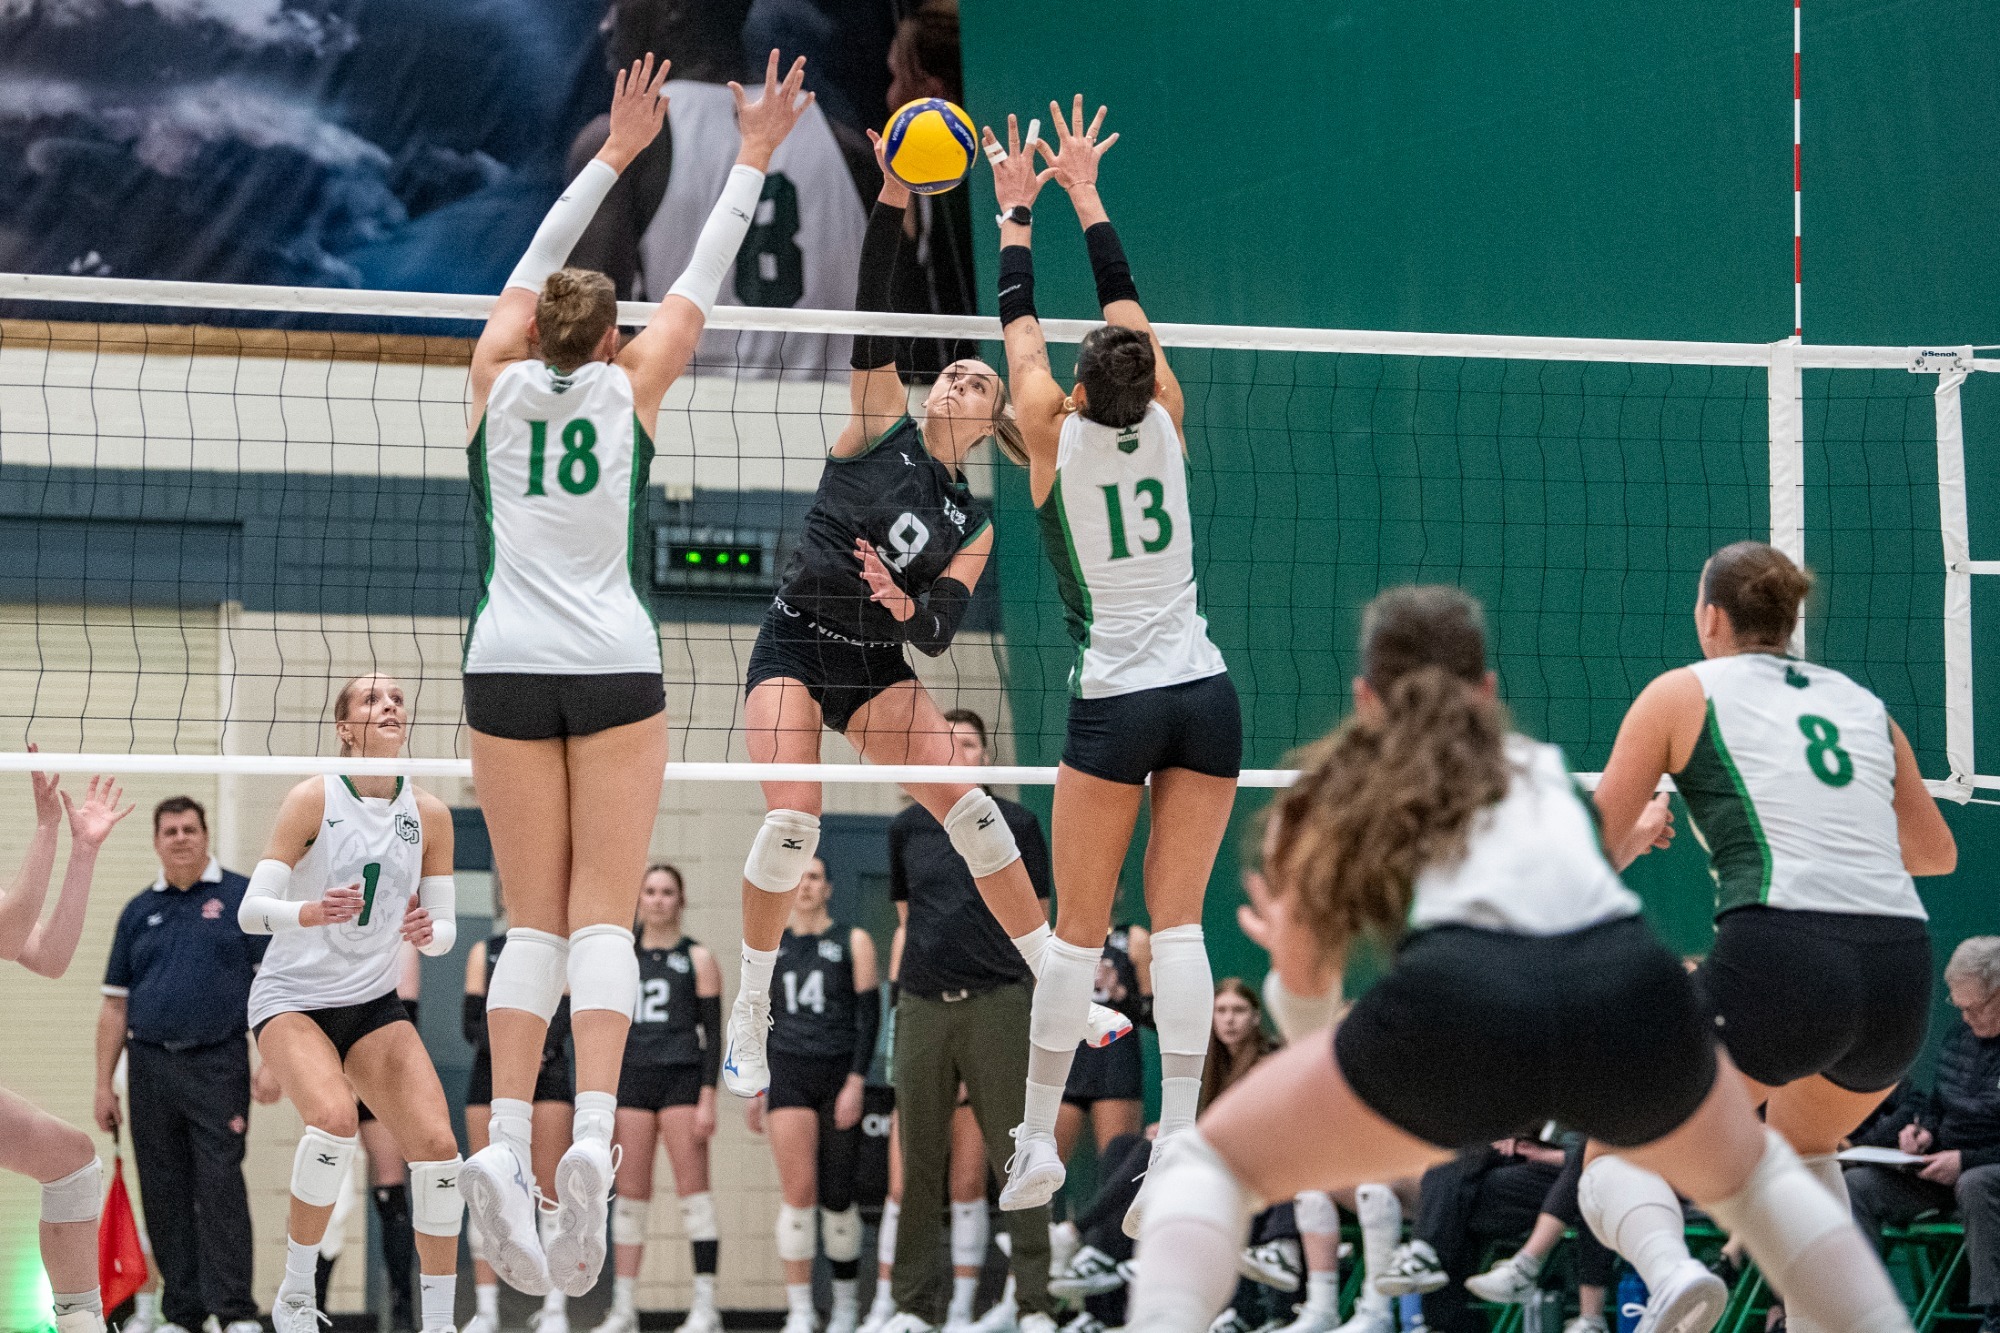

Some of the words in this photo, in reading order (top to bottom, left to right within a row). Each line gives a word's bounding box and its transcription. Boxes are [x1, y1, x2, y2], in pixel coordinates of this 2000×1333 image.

[522, 417, 600, 497] 18
[876, 511, 930, 573] 9
[1096, 477, 1173, 561] 13
[1797, 714, 1854, 788] 8
[357, 862, 381, 926] 1
[782, 969, 826, 1015] 14
